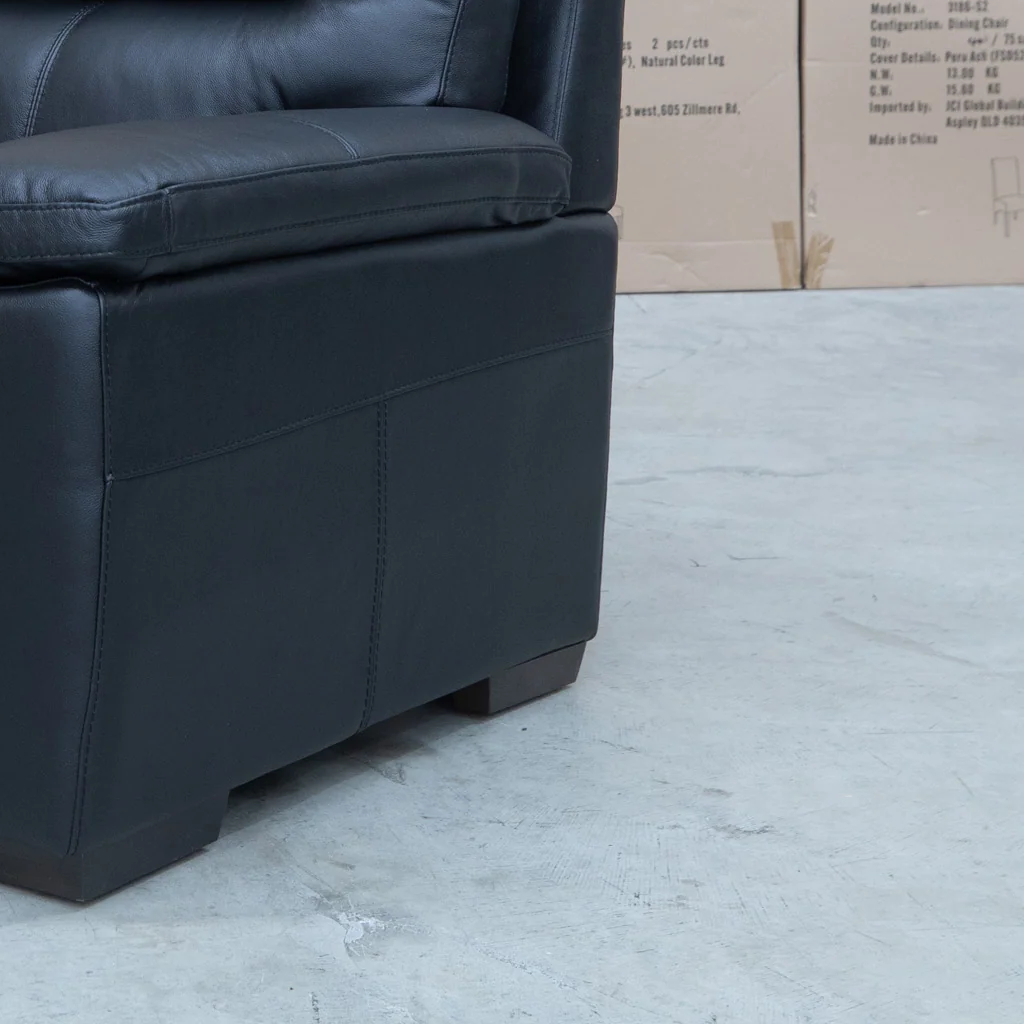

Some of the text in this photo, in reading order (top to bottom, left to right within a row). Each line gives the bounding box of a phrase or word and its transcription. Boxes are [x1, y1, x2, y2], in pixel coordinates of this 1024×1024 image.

[641, 54, 725, 68] Natural Color Leg
